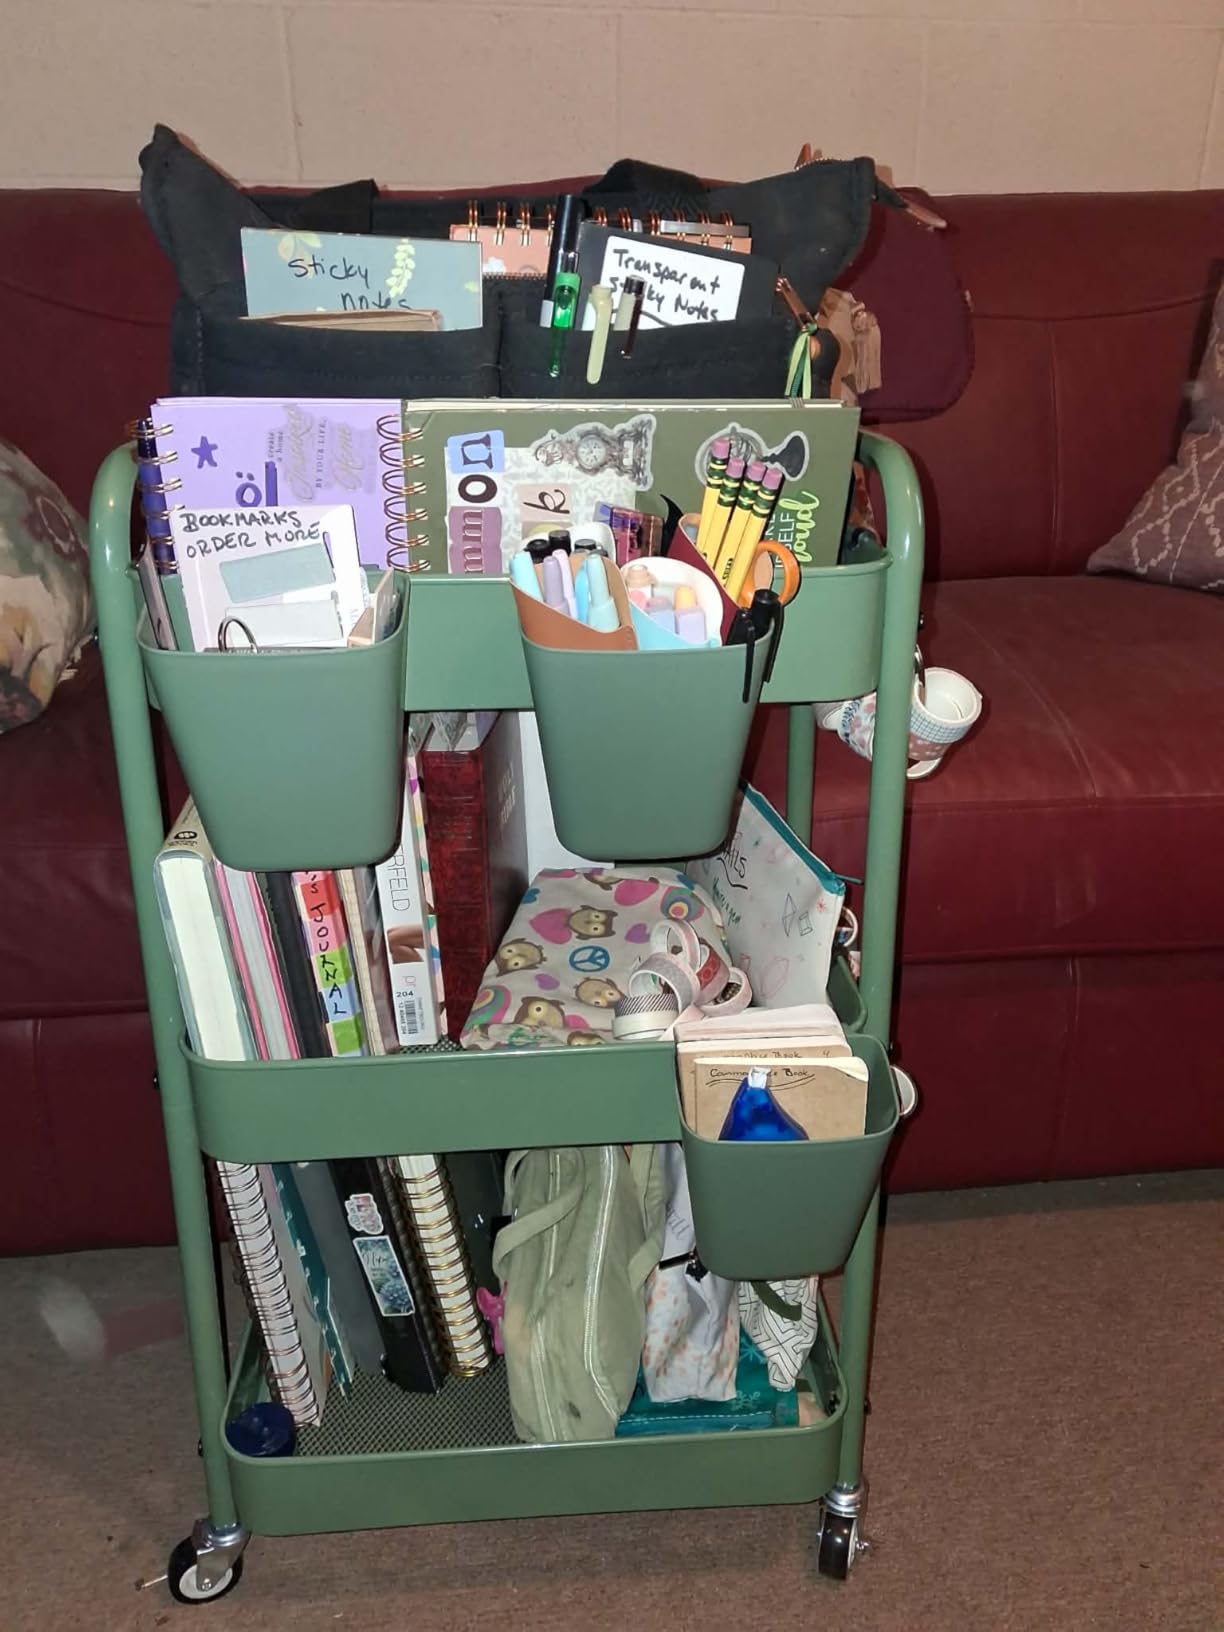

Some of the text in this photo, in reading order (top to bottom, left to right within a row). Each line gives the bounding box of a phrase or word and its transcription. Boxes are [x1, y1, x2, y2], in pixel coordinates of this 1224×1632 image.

[287, 254, 370, 289] Sticky
[179, 509, 301, 533] BOOKMARKS
[186, 520, 320, 558] ORDER MORE
[396, 990, 414, 998] 204
